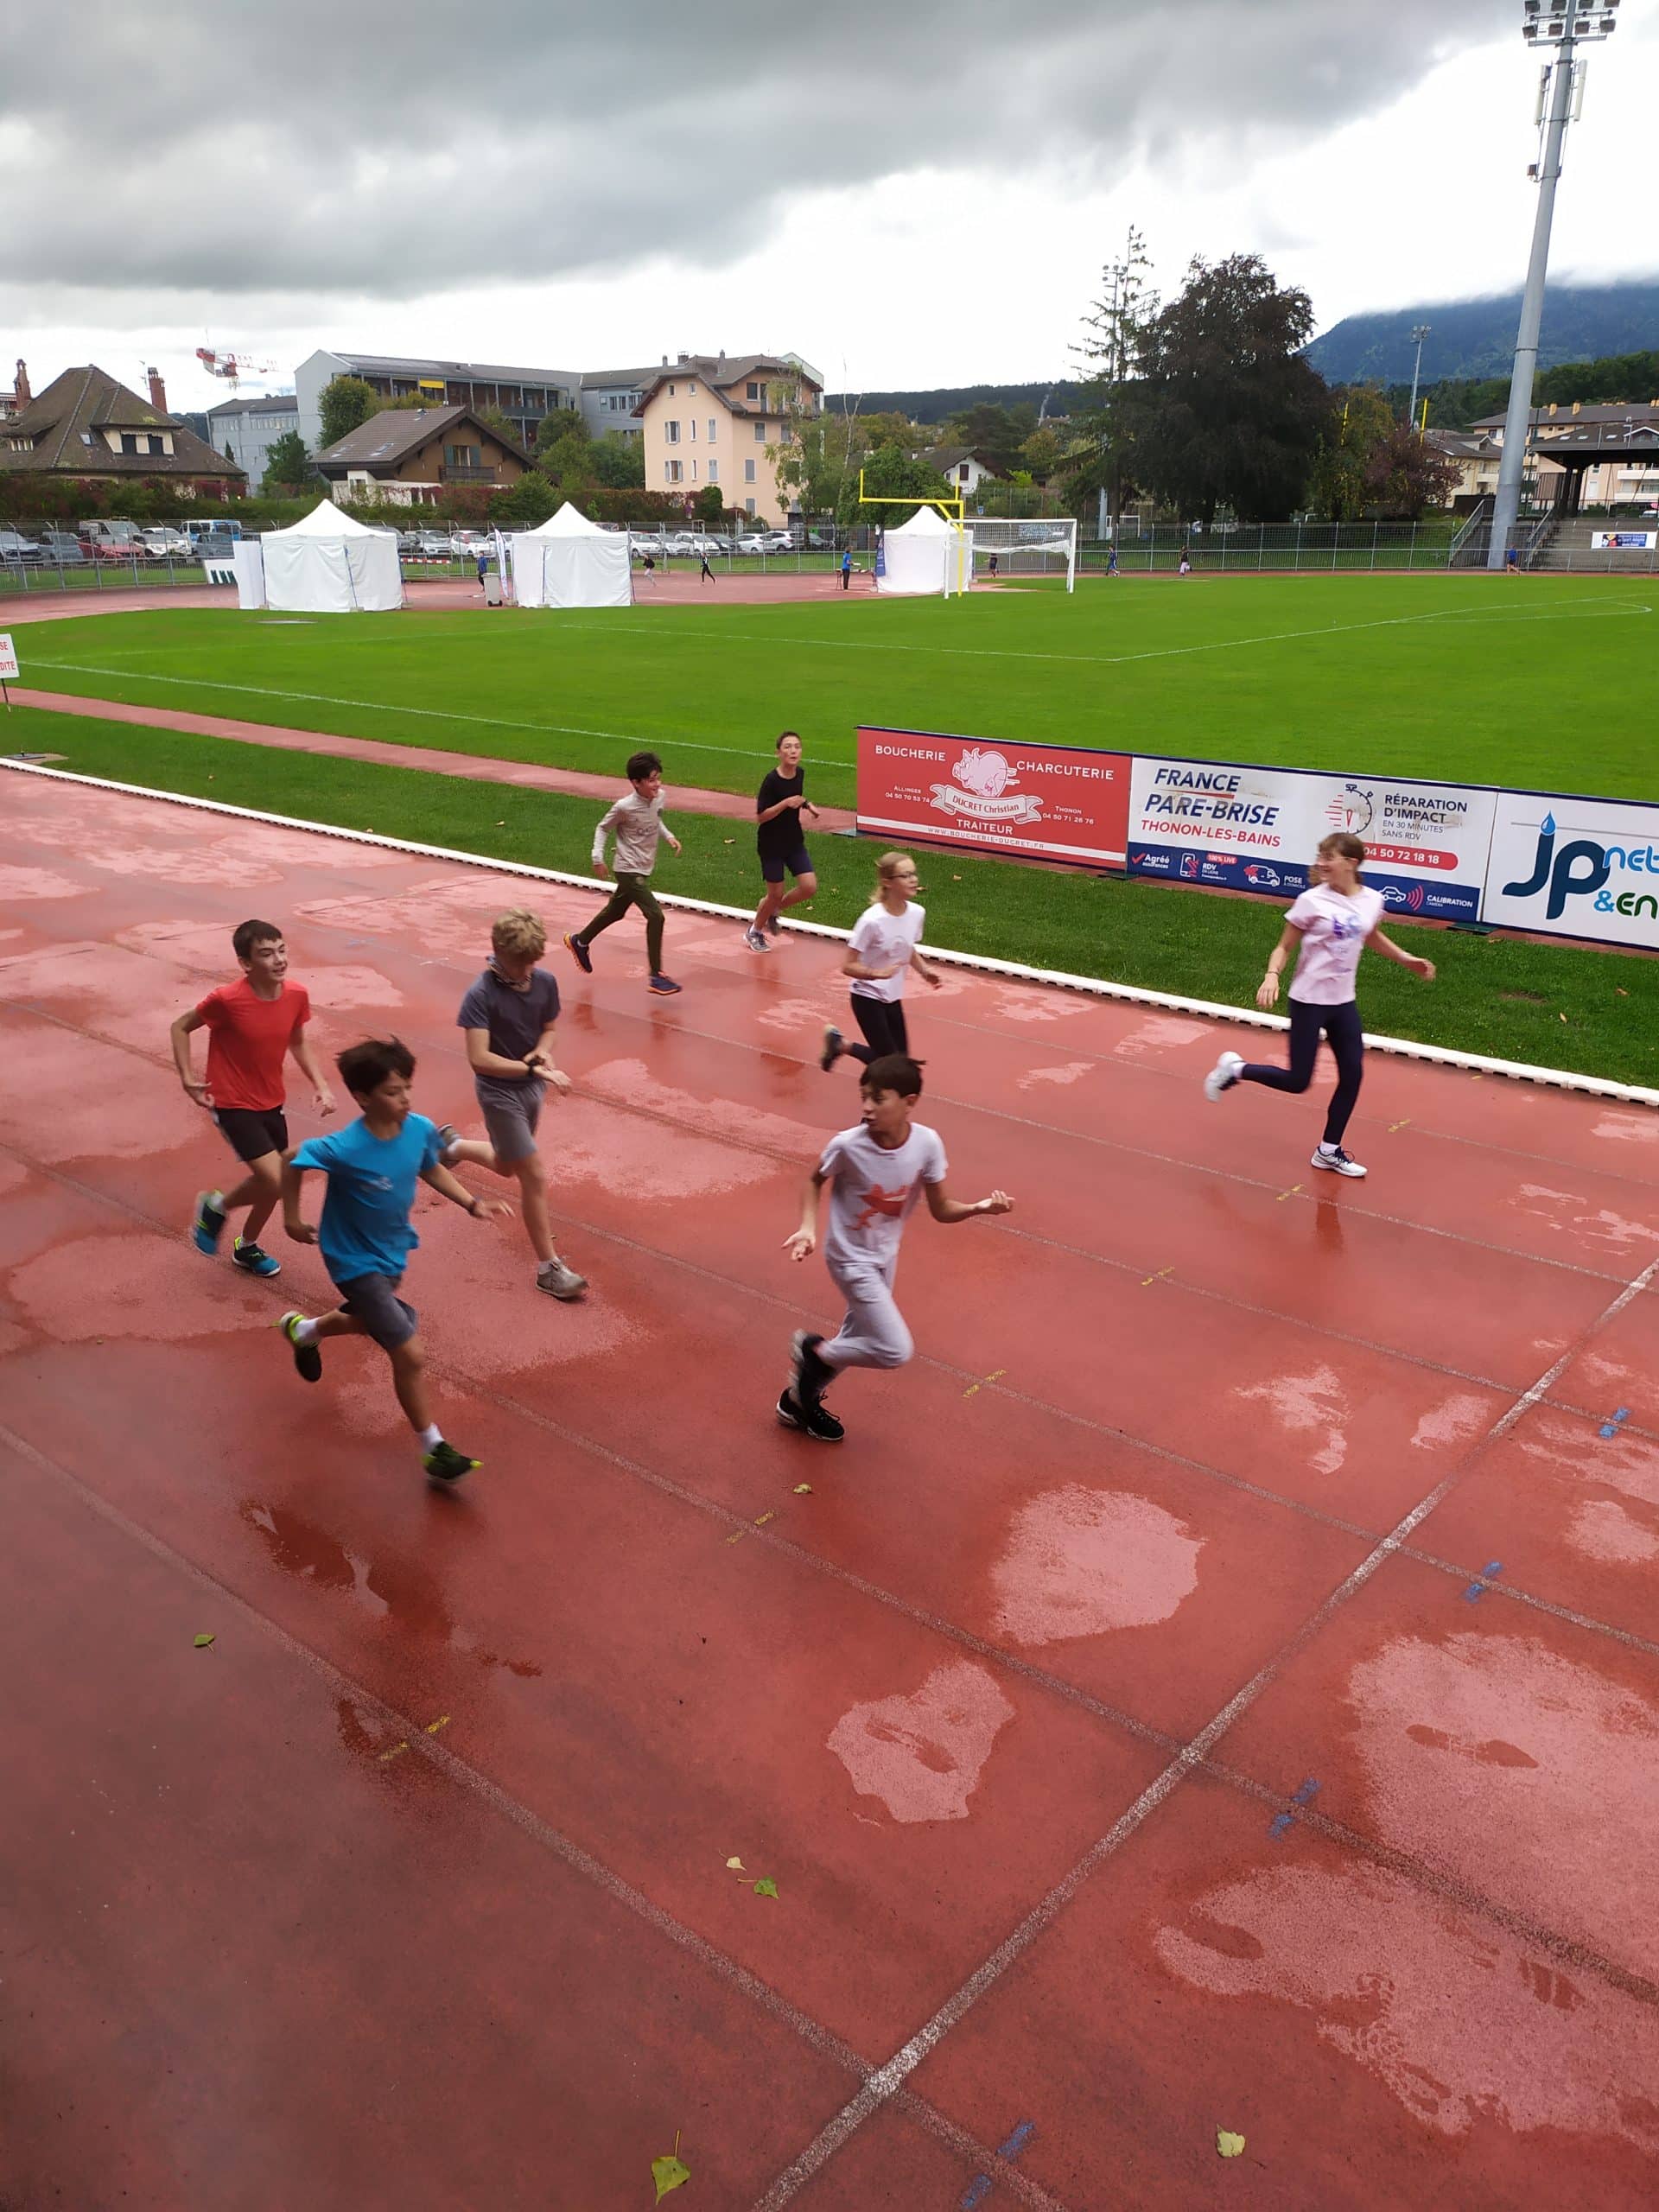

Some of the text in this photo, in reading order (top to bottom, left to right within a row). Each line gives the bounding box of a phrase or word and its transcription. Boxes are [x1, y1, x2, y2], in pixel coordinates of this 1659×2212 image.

[0, 660, 16, 671] DITE
[875, 745, 946, 761] BOUCHERIE
[1016, 760, 1114, 780] CHARCUTERIE
[1154, 768, 1242, 792] FRANCE
[952, 795, 1020, 814] DUCRET Christian
[1055, 805, 1082, 815] THONON
[1144, 793, 1280, 826] PARE-BRISE
[1384, 793, 1468, 813] RÉPARATION
[1384, 807, 1446, 824] D'IMPACT
[957, 818, 1014, 836] TRAITEUR
[1141, 819, 1281, 847] THONON-LES-BAINS
[1382, 819, 1444, 834] EN 30 MINUTES
[1382, 830, 1421, 841] SANS RDV
[1363, 847, 1440, 864] 04 50 72 18 18
[1203, 862, 1217, 871] RDV
[1284, 875, 1303, 885] POSE
[1427, 894, 1473, 908] CALIBRATION
